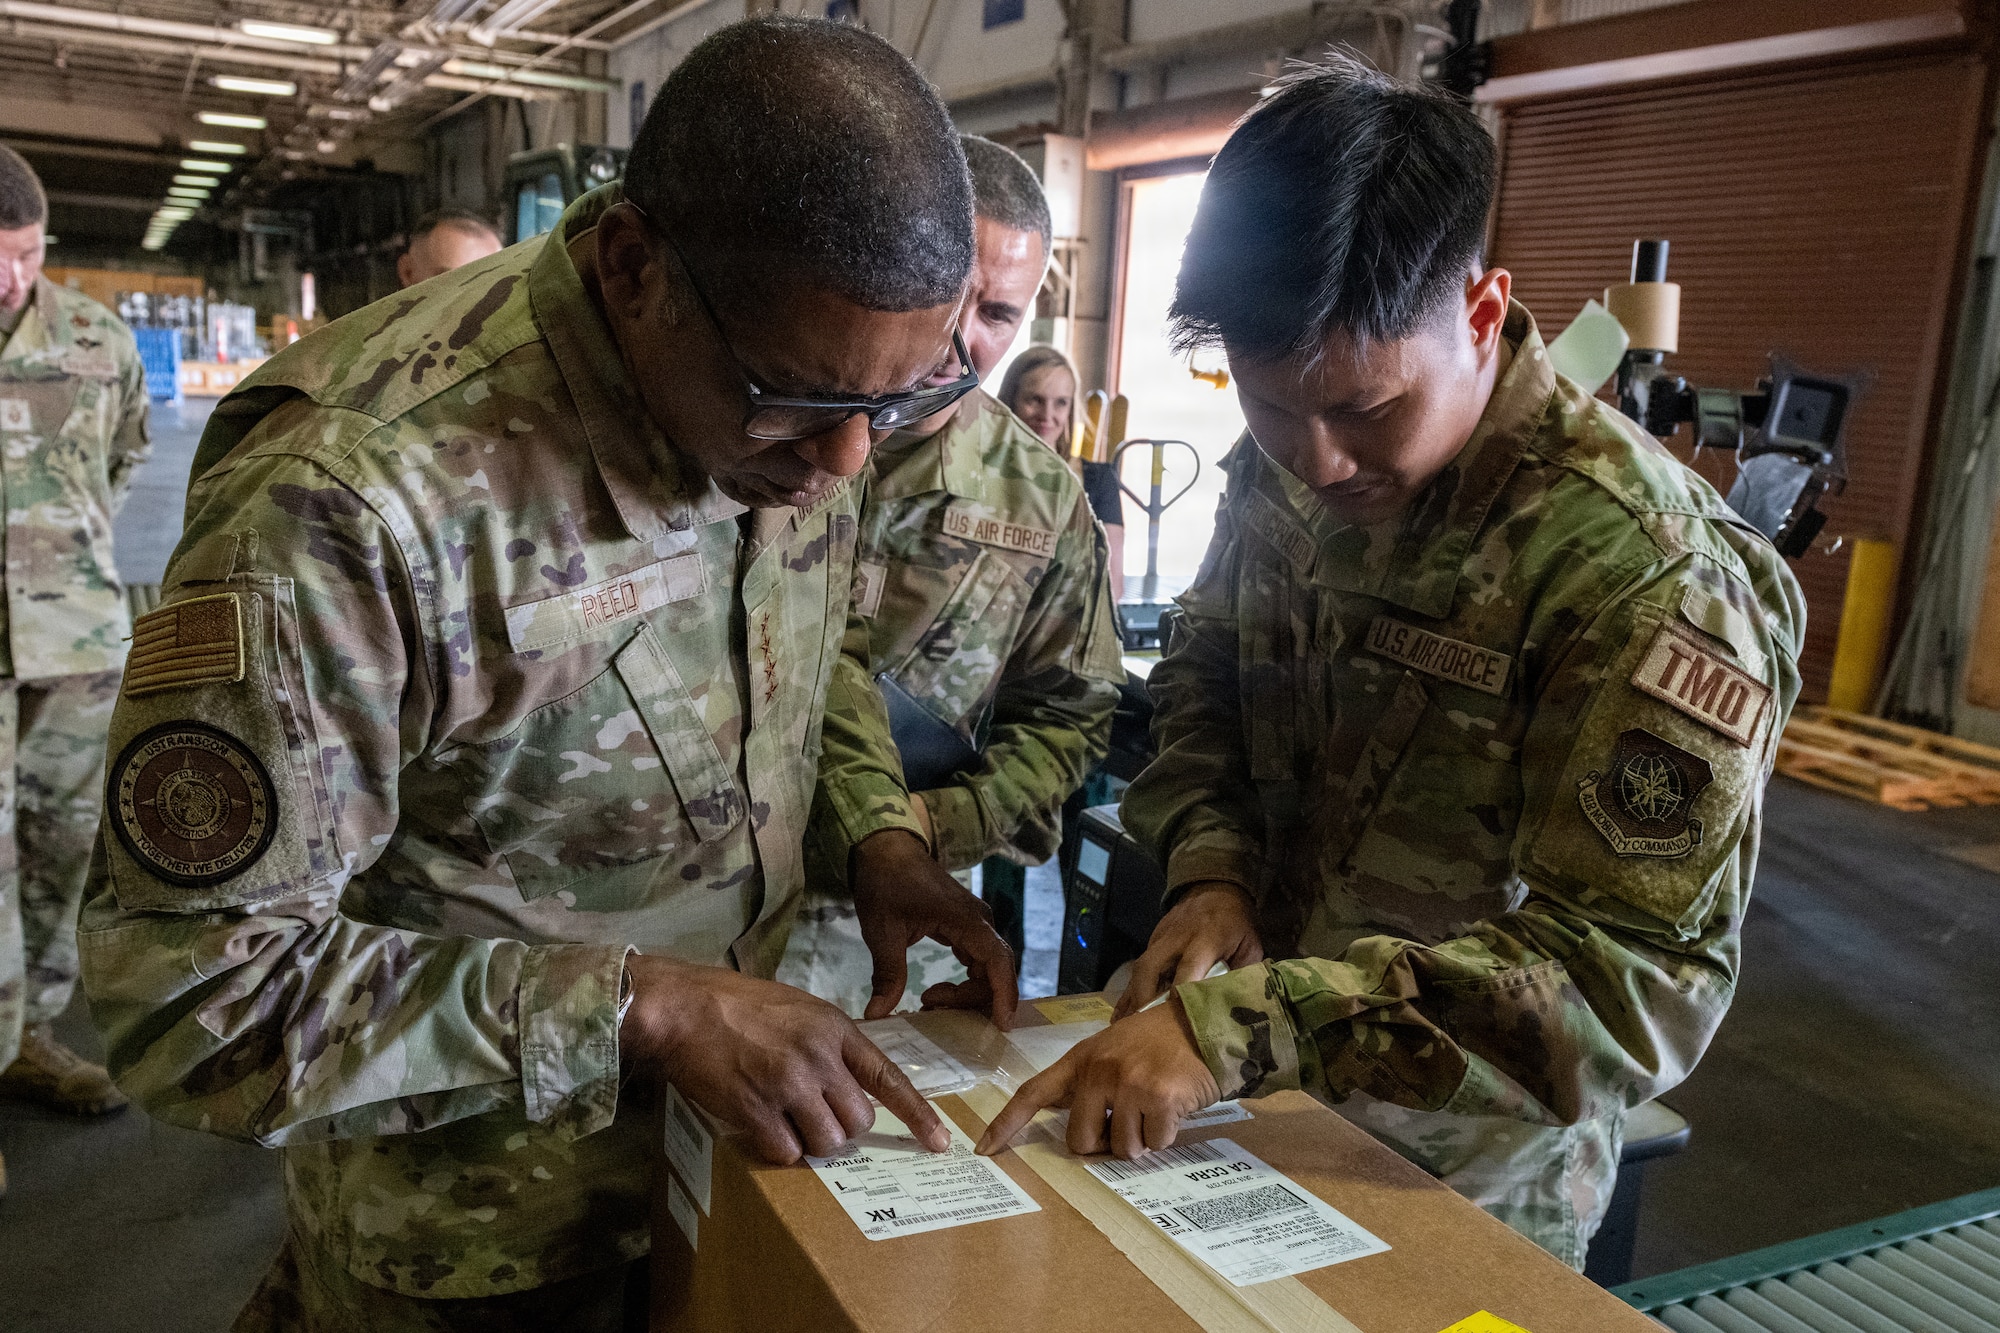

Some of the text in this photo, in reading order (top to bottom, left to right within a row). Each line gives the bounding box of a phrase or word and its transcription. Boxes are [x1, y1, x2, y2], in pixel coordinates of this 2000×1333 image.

[973, 520, 999, 542] AIR
[1002, 525, 1052, 553] FORCE
[581, 579, 640, 628] REED
[1373, 621, 1500, 687] U.S. AIR FORCE
[1657, 642, 1751, 726] TMO
[145, 735, 230, 757] USTRANSCOM
[1582, 793, 1688, 851] AIR MOBILITY COMMAND
[136, 834, 257, 874] TOGETHER WE DELIVER
[824, 1156, 874, 1169] W91KGP
[1182, 1160, 1254, 1182] CA CCRA
[835, 1181, 849, 1191] 1
[1176, 1194, 1193, 1202] TUE
[1145, 1201, 1163, 1209] JUN
[865, 1207, 897, 1223] AK
[1150, 1215, 1172, 1228] E
[1294, 1214, 1320, 1223] TRAVIS
[1167, 1227, 1193, 1236] FedE
[1261, 1234, 1283, 1242] BLDG
[1316, 1230, 1346, 1240] PERSON
[1205, 1241, 1232, 1251] CARGO
[1282, 1238, 1313, 1249] CHARGE
